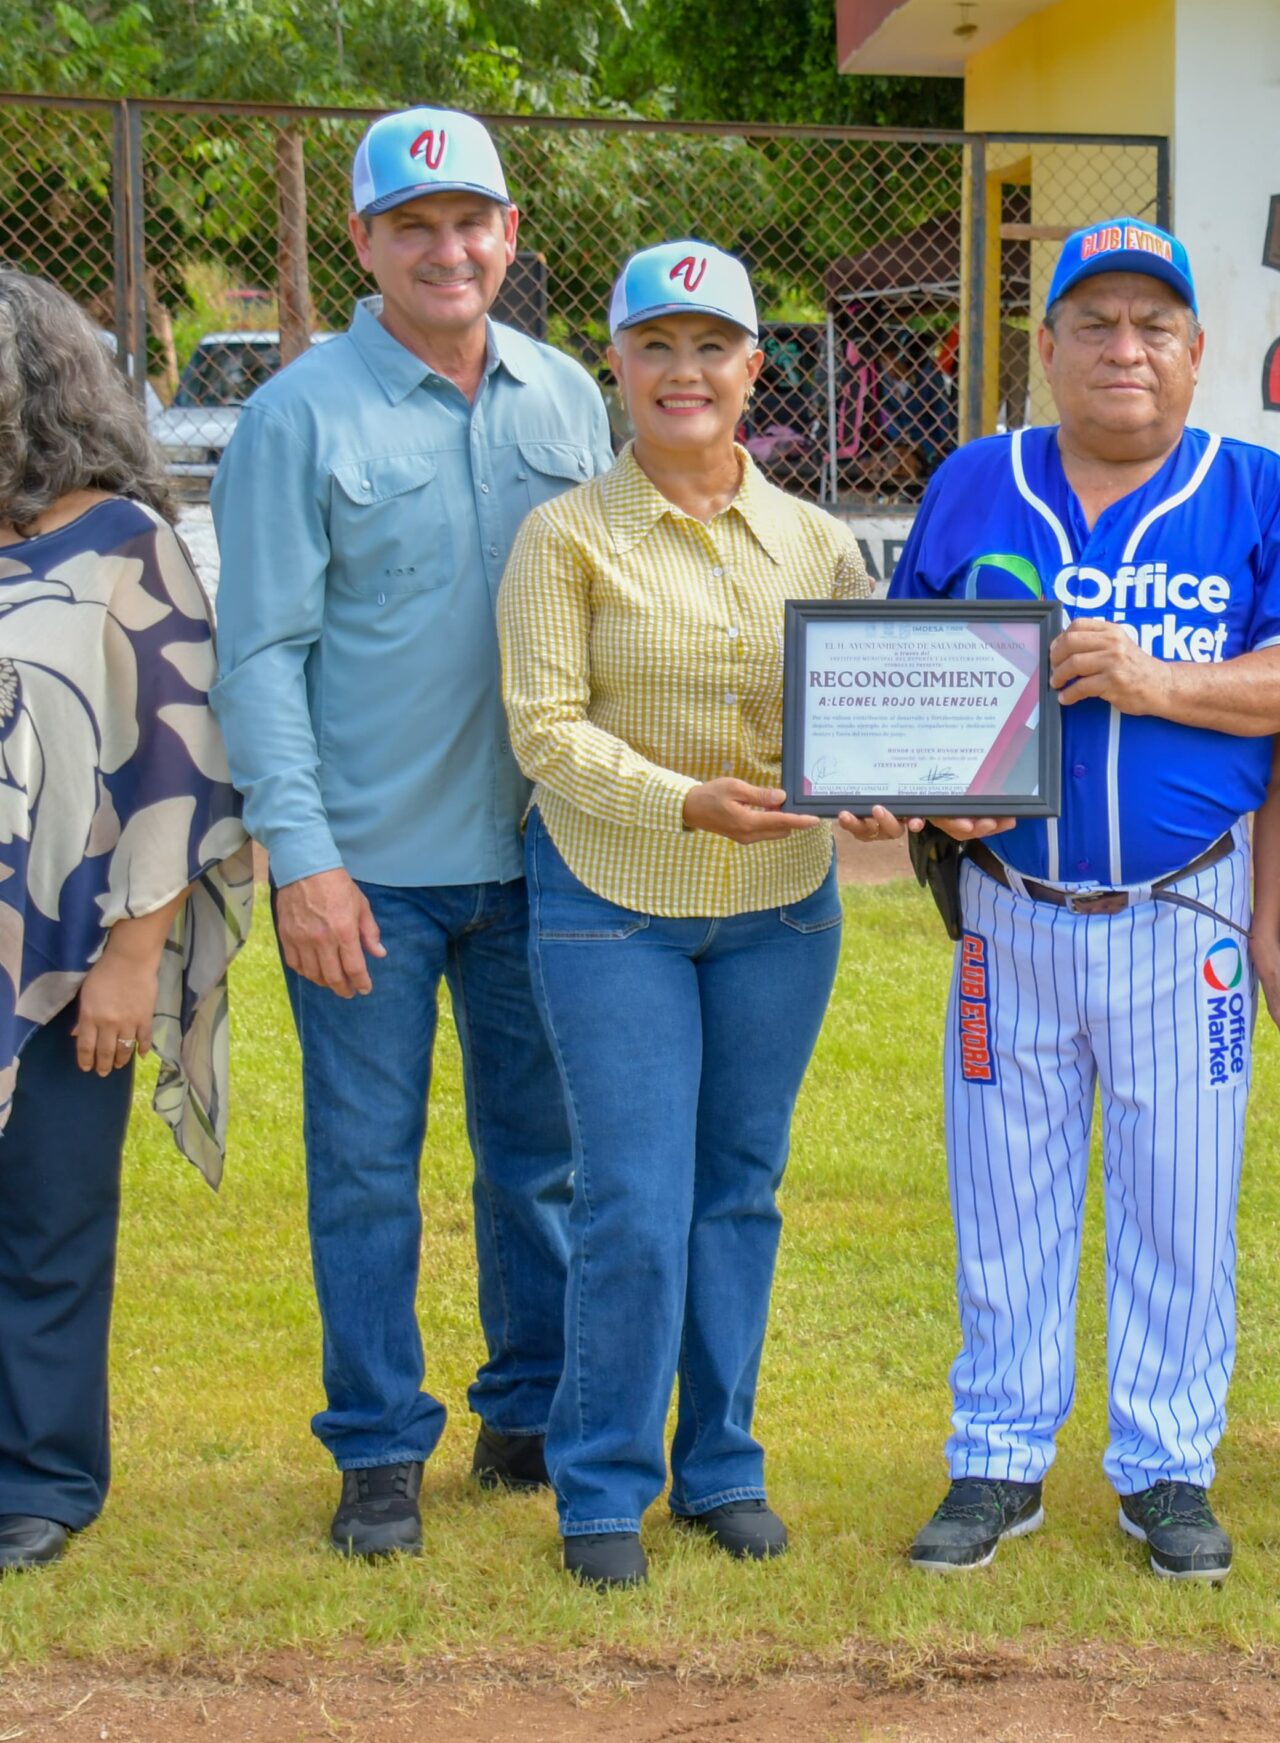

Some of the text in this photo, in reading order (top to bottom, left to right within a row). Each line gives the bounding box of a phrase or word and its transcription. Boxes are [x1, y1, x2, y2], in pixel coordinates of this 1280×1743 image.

[1081, 226, 1122, 261] CLUB
[1054, 562, 1231, 613] Office
[809, 671, 1015, 688] RECONOCIMIENTO
[818, 696, 998, 707] A:LEONEL ROJO VALENZUELA
[960, 935, 993, 1081] CLUB EVORA
[1228, 993, 1244, 1074] Office
[1206, 997, 1229, 1086] Market
